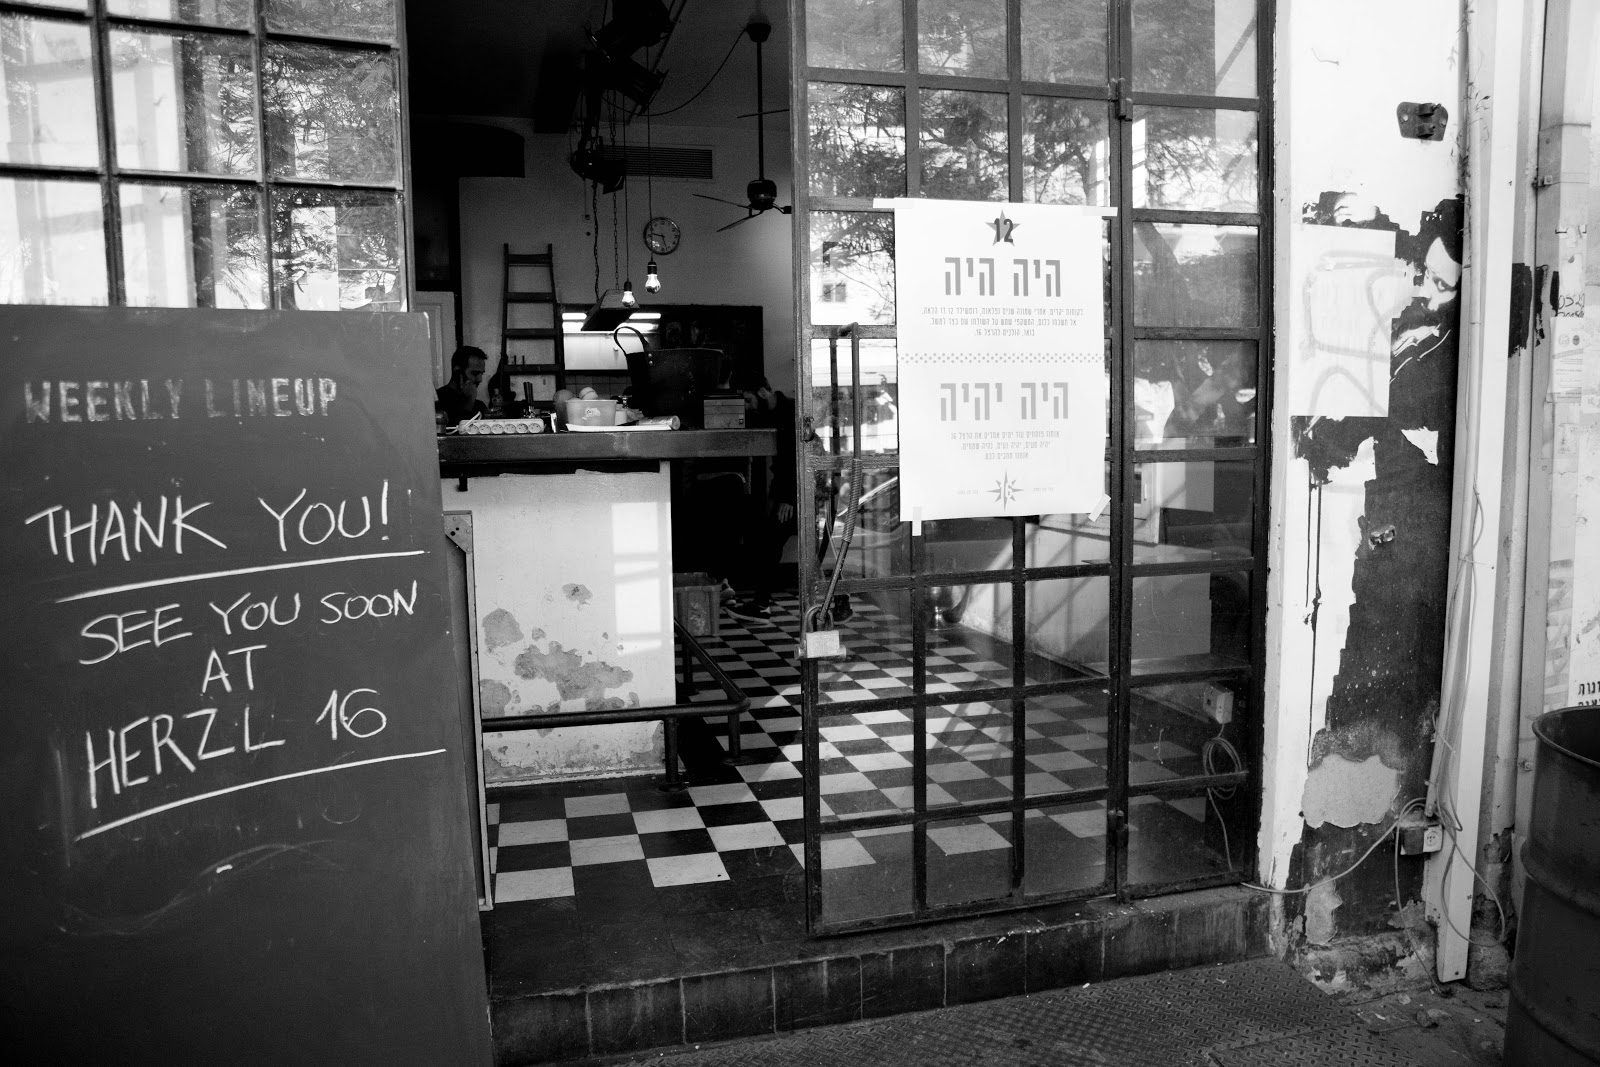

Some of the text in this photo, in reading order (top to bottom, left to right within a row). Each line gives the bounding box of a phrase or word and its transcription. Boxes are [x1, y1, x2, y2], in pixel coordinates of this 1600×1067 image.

[994, 218, 1014, 242] 12
[945, 257, 1061, 297] היה היה
[24, 377, 337, 424] WEEKLY LINEUP
[940, 382, 1068, 421] היה יהיה
[25, 479, 390, 565] THANK YOU!
[79, 580, 418, 664] SEE YOU SOON
[201, 645, 267, 693] AT
[86, 688, 387, 809] HERZL 16
